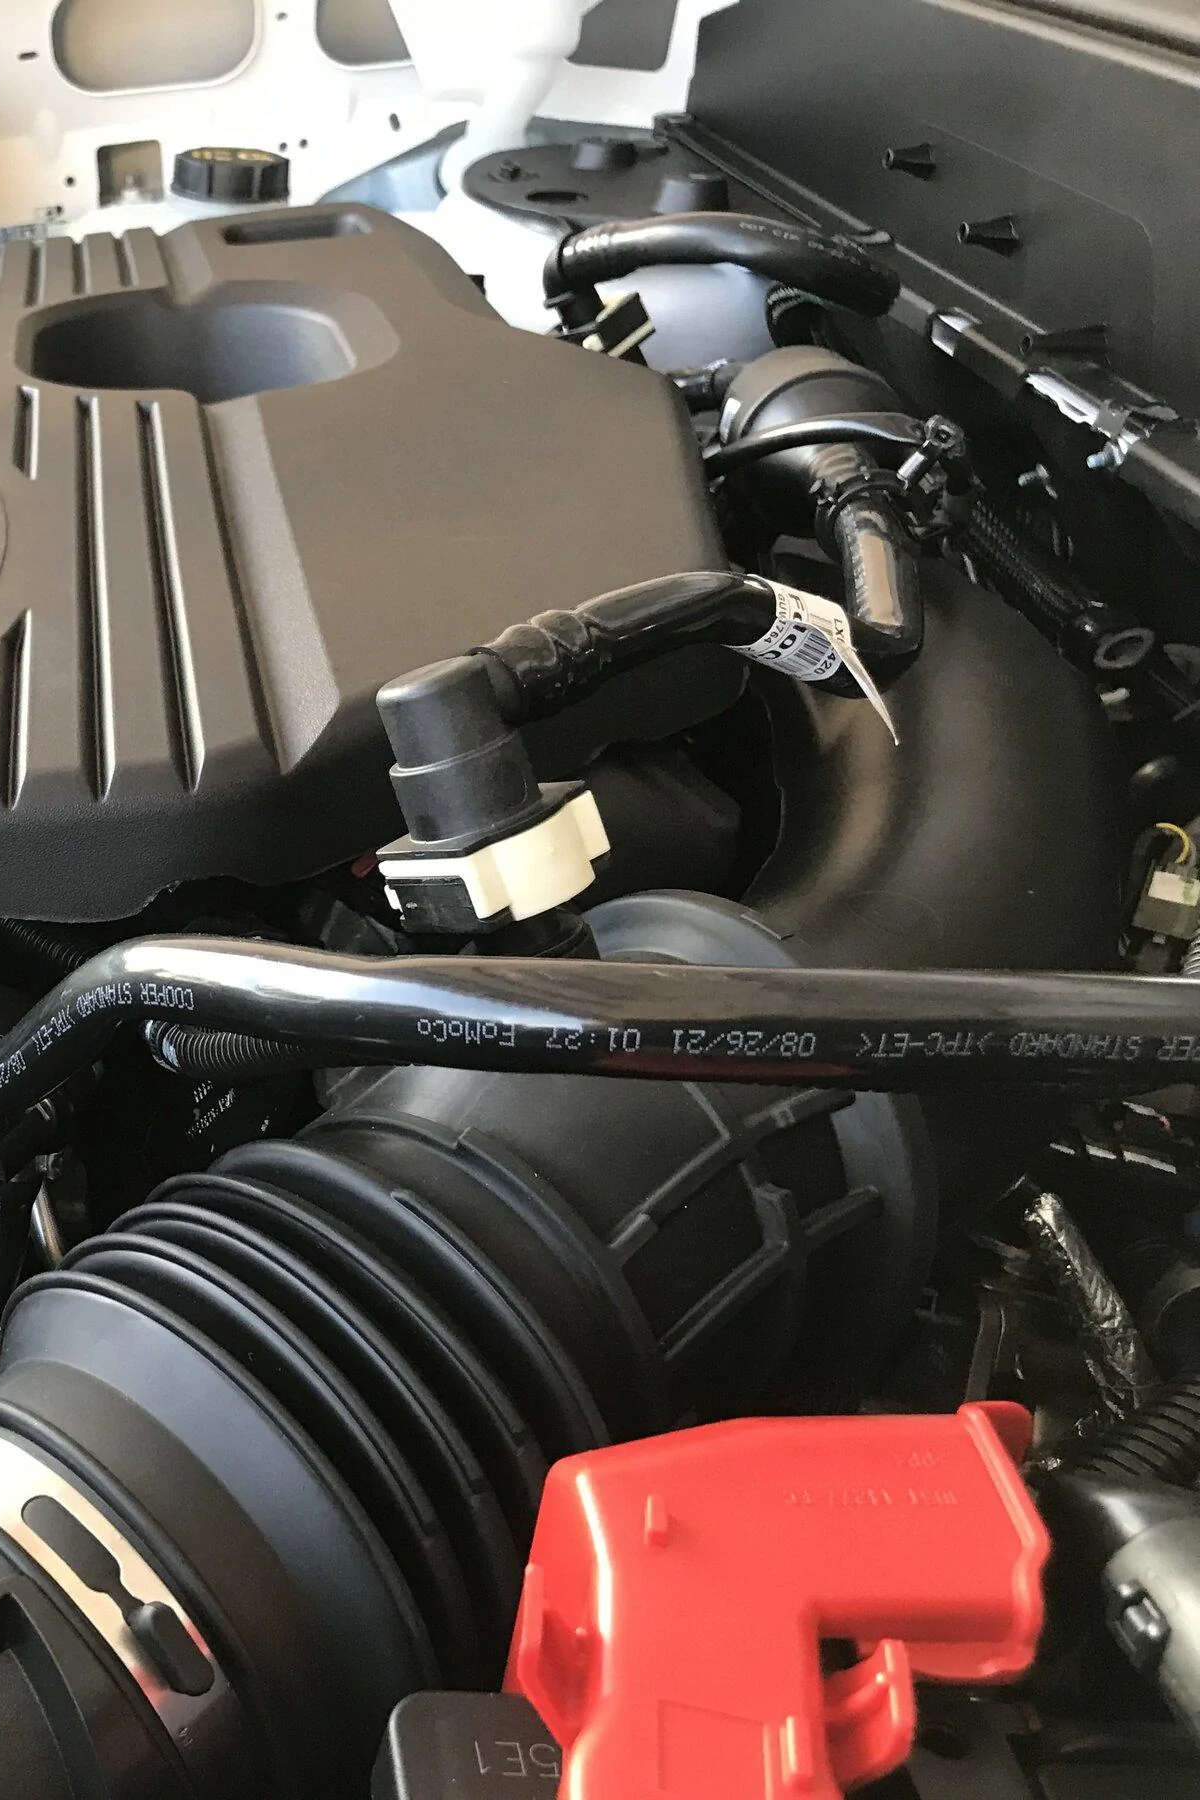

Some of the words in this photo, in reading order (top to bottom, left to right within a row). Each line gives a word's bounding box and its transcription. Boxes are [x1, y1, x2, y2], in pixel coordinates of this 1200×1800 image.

[75, 982, 133, 1018] STANDARD
[139, 982, 195, 1011] COOPER
[416, 1018, 516, 1047] FoMoCo
[546, 1027, 641, 1052] 01:27
[672, 1031, 817, 1057] 08/26/21
[1008, 1031, 1144, 1061] STANDARD
[474, 1740, 561, 1777] 5E1
